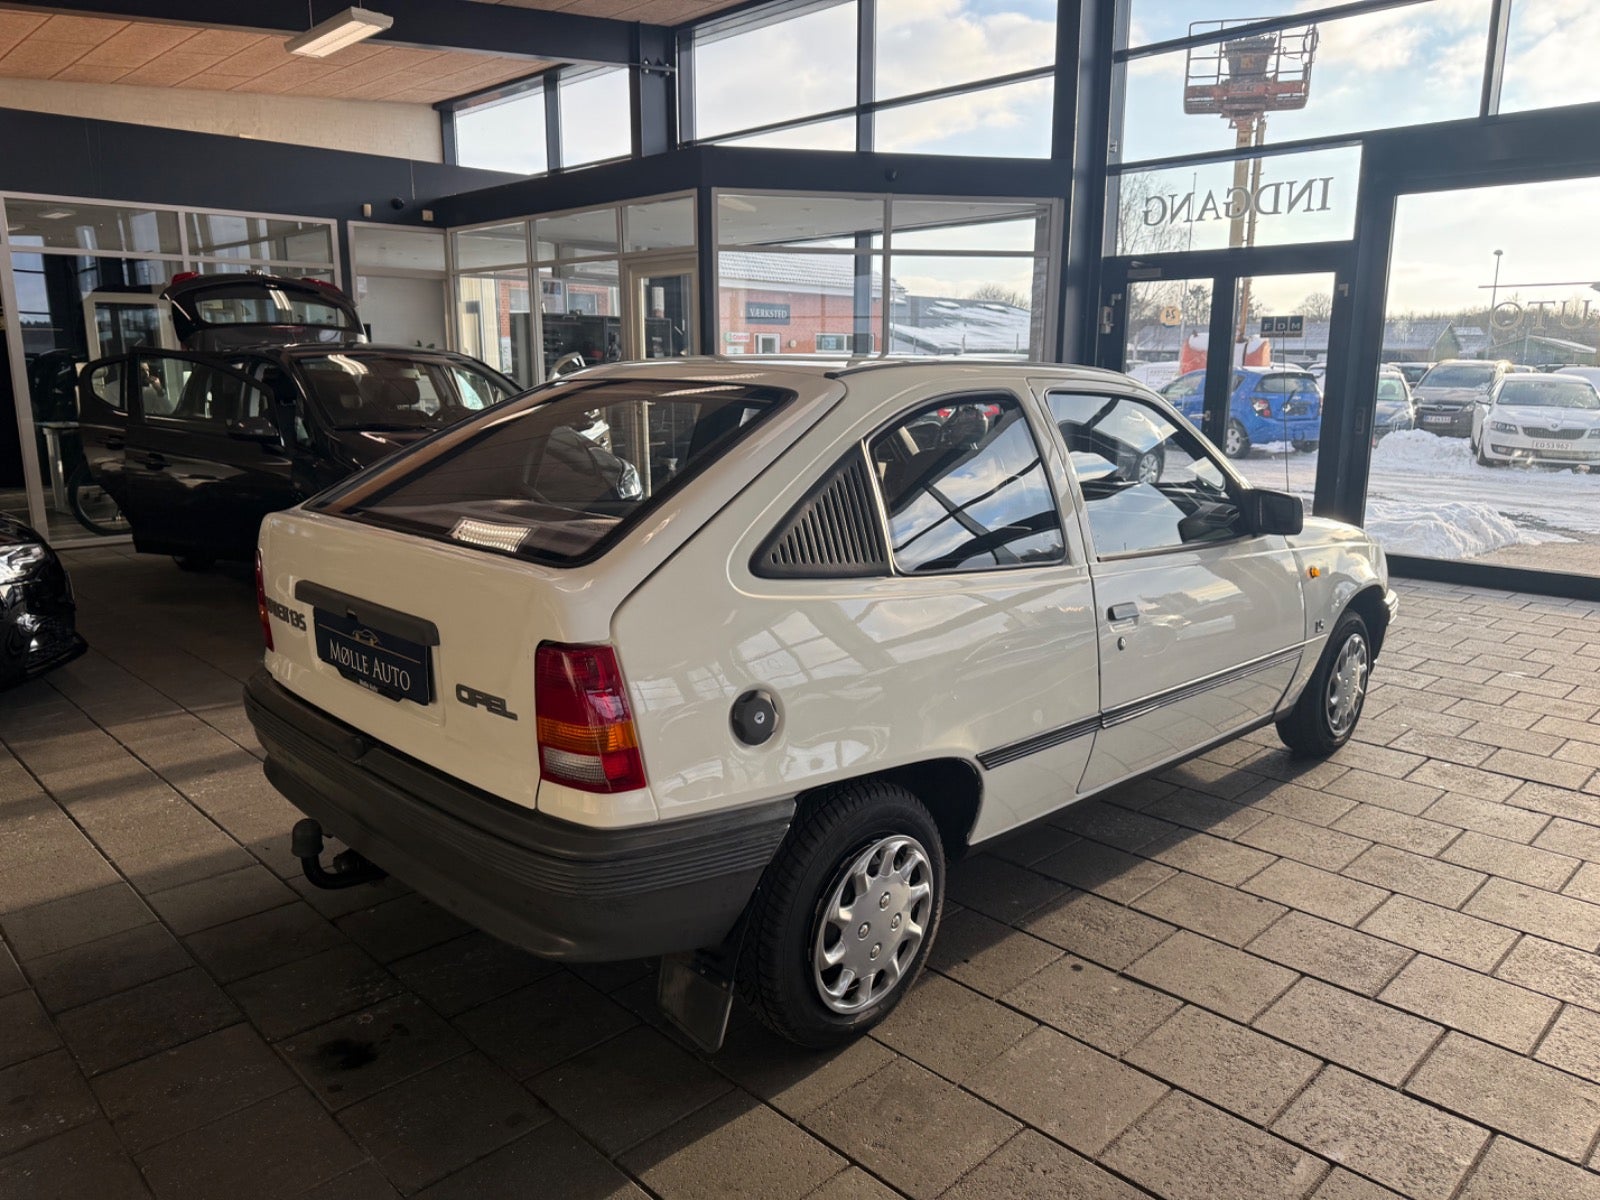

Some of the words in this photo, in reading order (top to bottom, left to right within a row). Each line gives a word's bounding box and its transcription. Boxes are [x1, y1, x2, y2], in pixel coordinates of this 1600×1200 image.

[750, 308, 788, 319] VÆRKSTED
[1264, 322, 1301, 330] FDM
[329, 639, 370, 675] MØLLE
[372, 657, 411, 691] AUTO
[456, 683, 518, 721] OPEL
